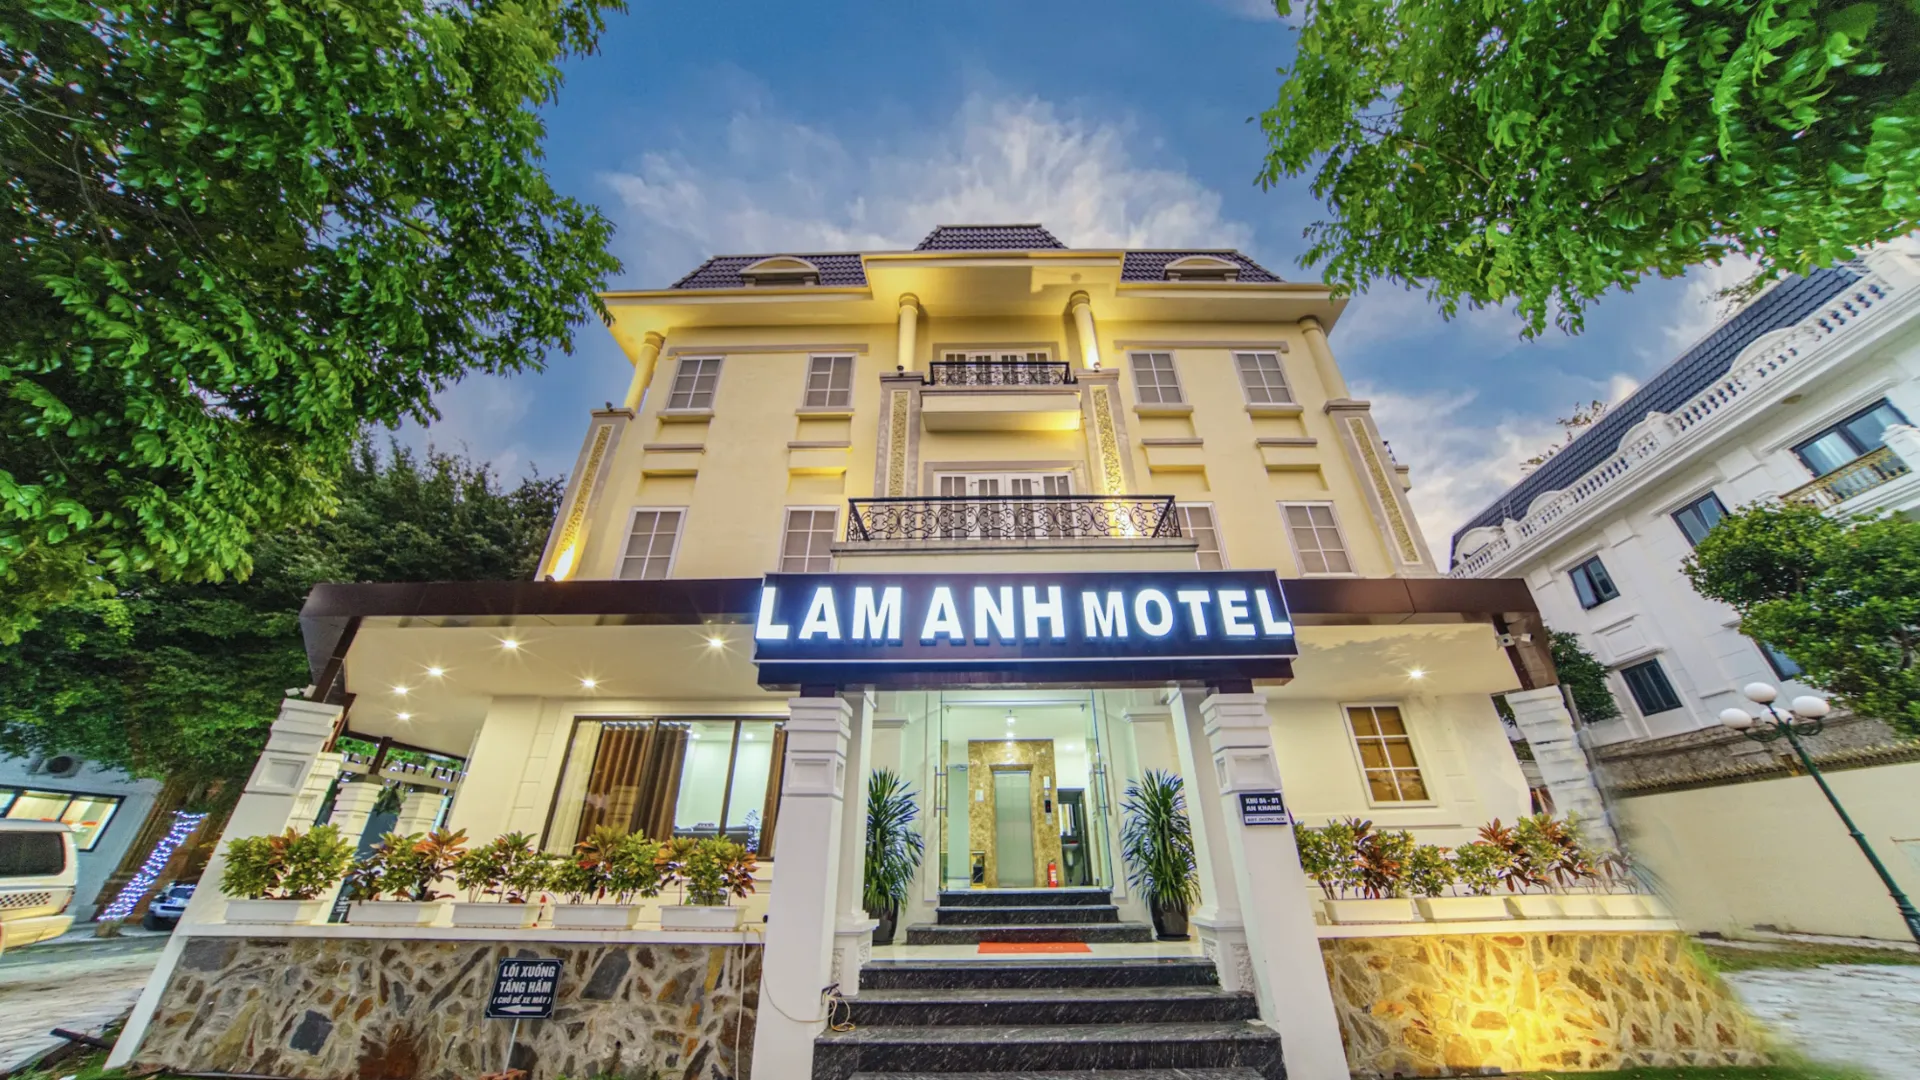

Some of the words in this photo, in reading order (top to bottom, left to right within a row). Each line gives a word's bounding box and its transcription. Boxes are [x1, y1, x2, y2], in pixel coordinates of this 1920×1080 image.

[755, 586, 902, 640] LAM
[920, 586, 1066, 639] ANH
[1081, 588, 1294, 638] MOTEL
[503, 963, 520, 977] LỐI
[520, 963, 555, 977] XUỐNG
[499, 978, 527, 993] TẦNG
[527, 978, 552, 993] HẦM
